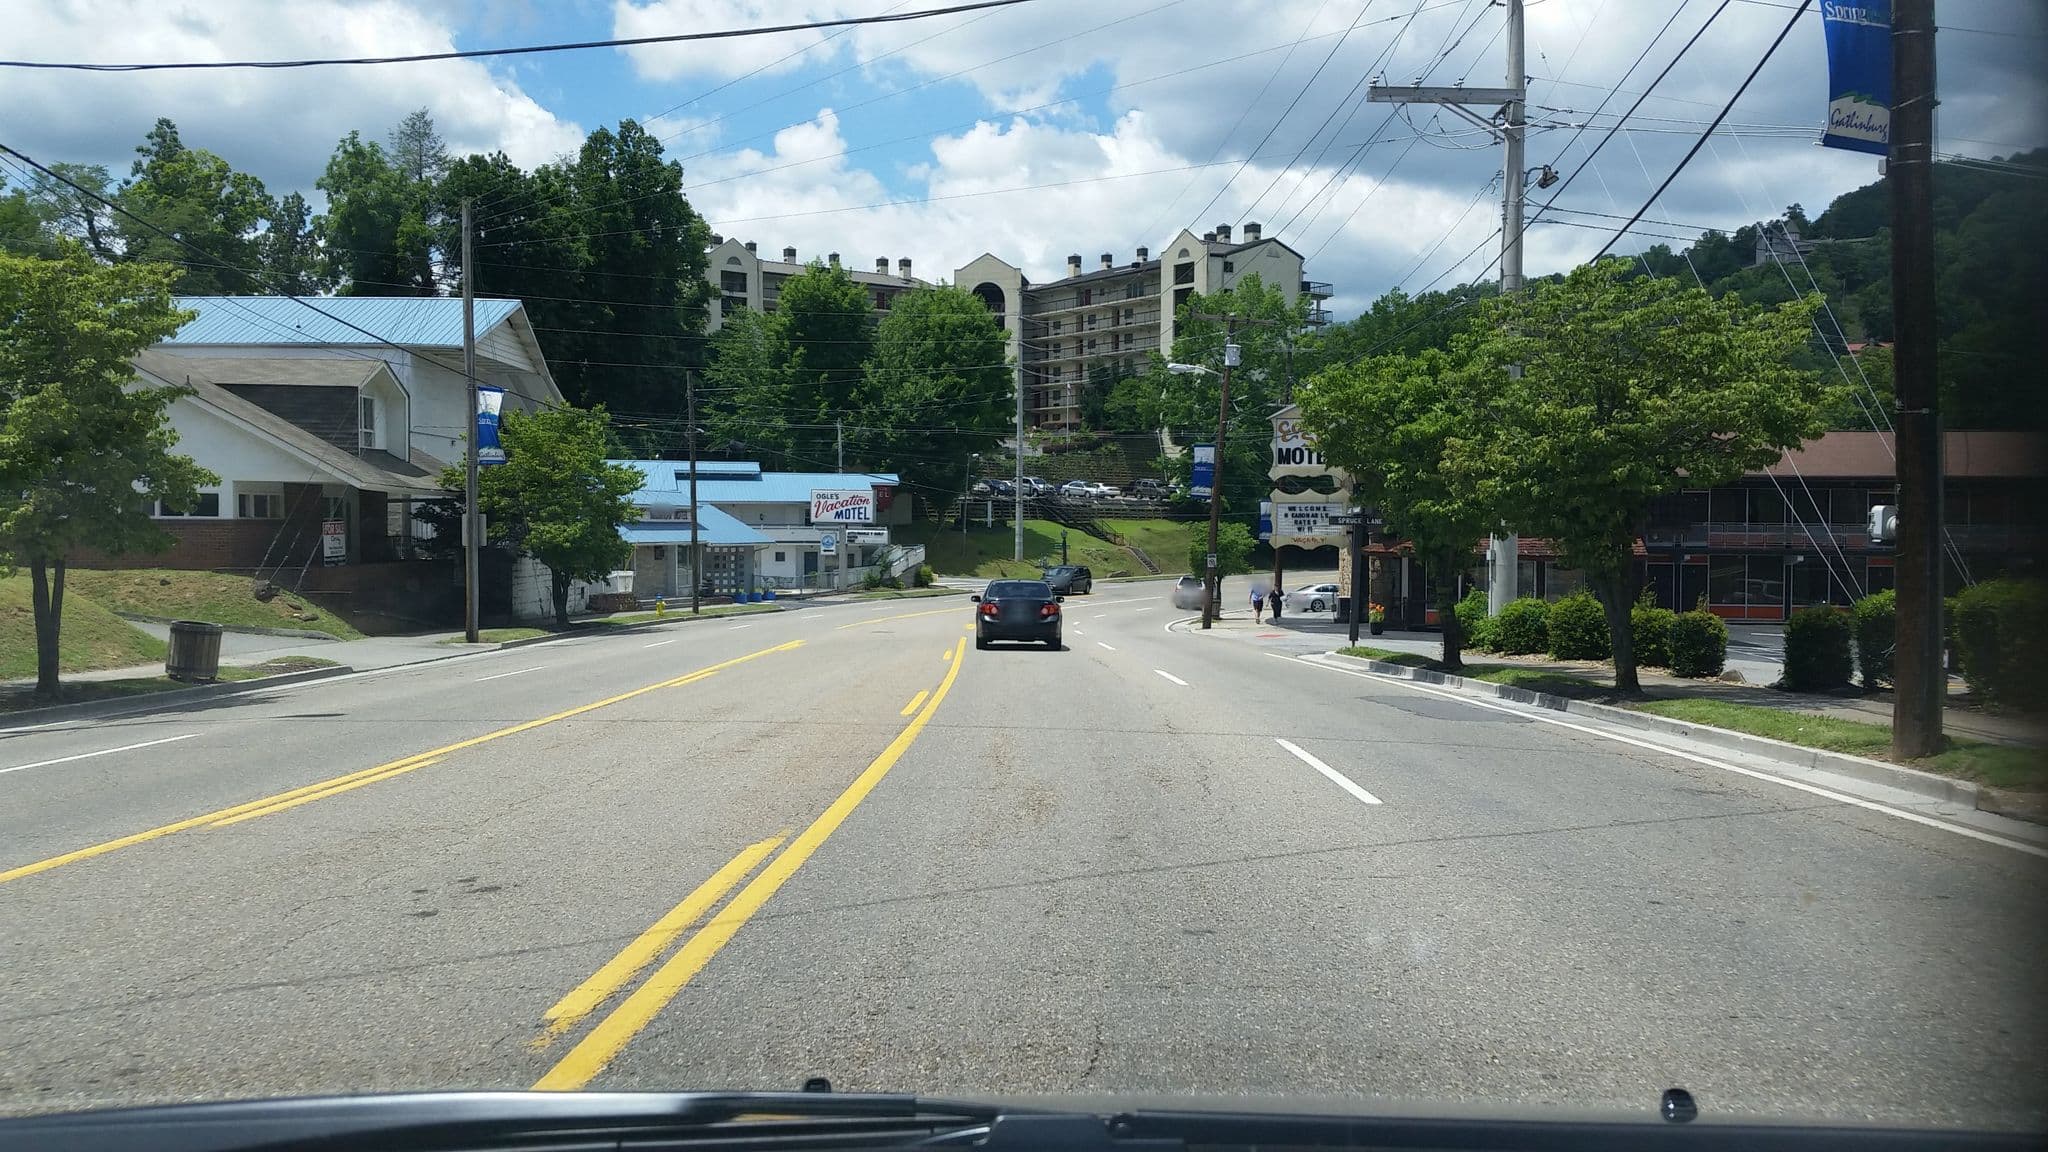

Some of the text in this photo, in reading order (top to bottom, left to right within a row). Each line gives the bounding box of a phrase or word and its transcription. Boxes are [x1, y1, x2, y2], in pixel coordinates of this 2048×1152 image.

[1831, 108, 1888, 140] Gatlinburg
[1278, 447, 1325, 465] MOTE
[814, 495, 871, 518] Vacation
[834, 506, 870, 520] MOTEL
